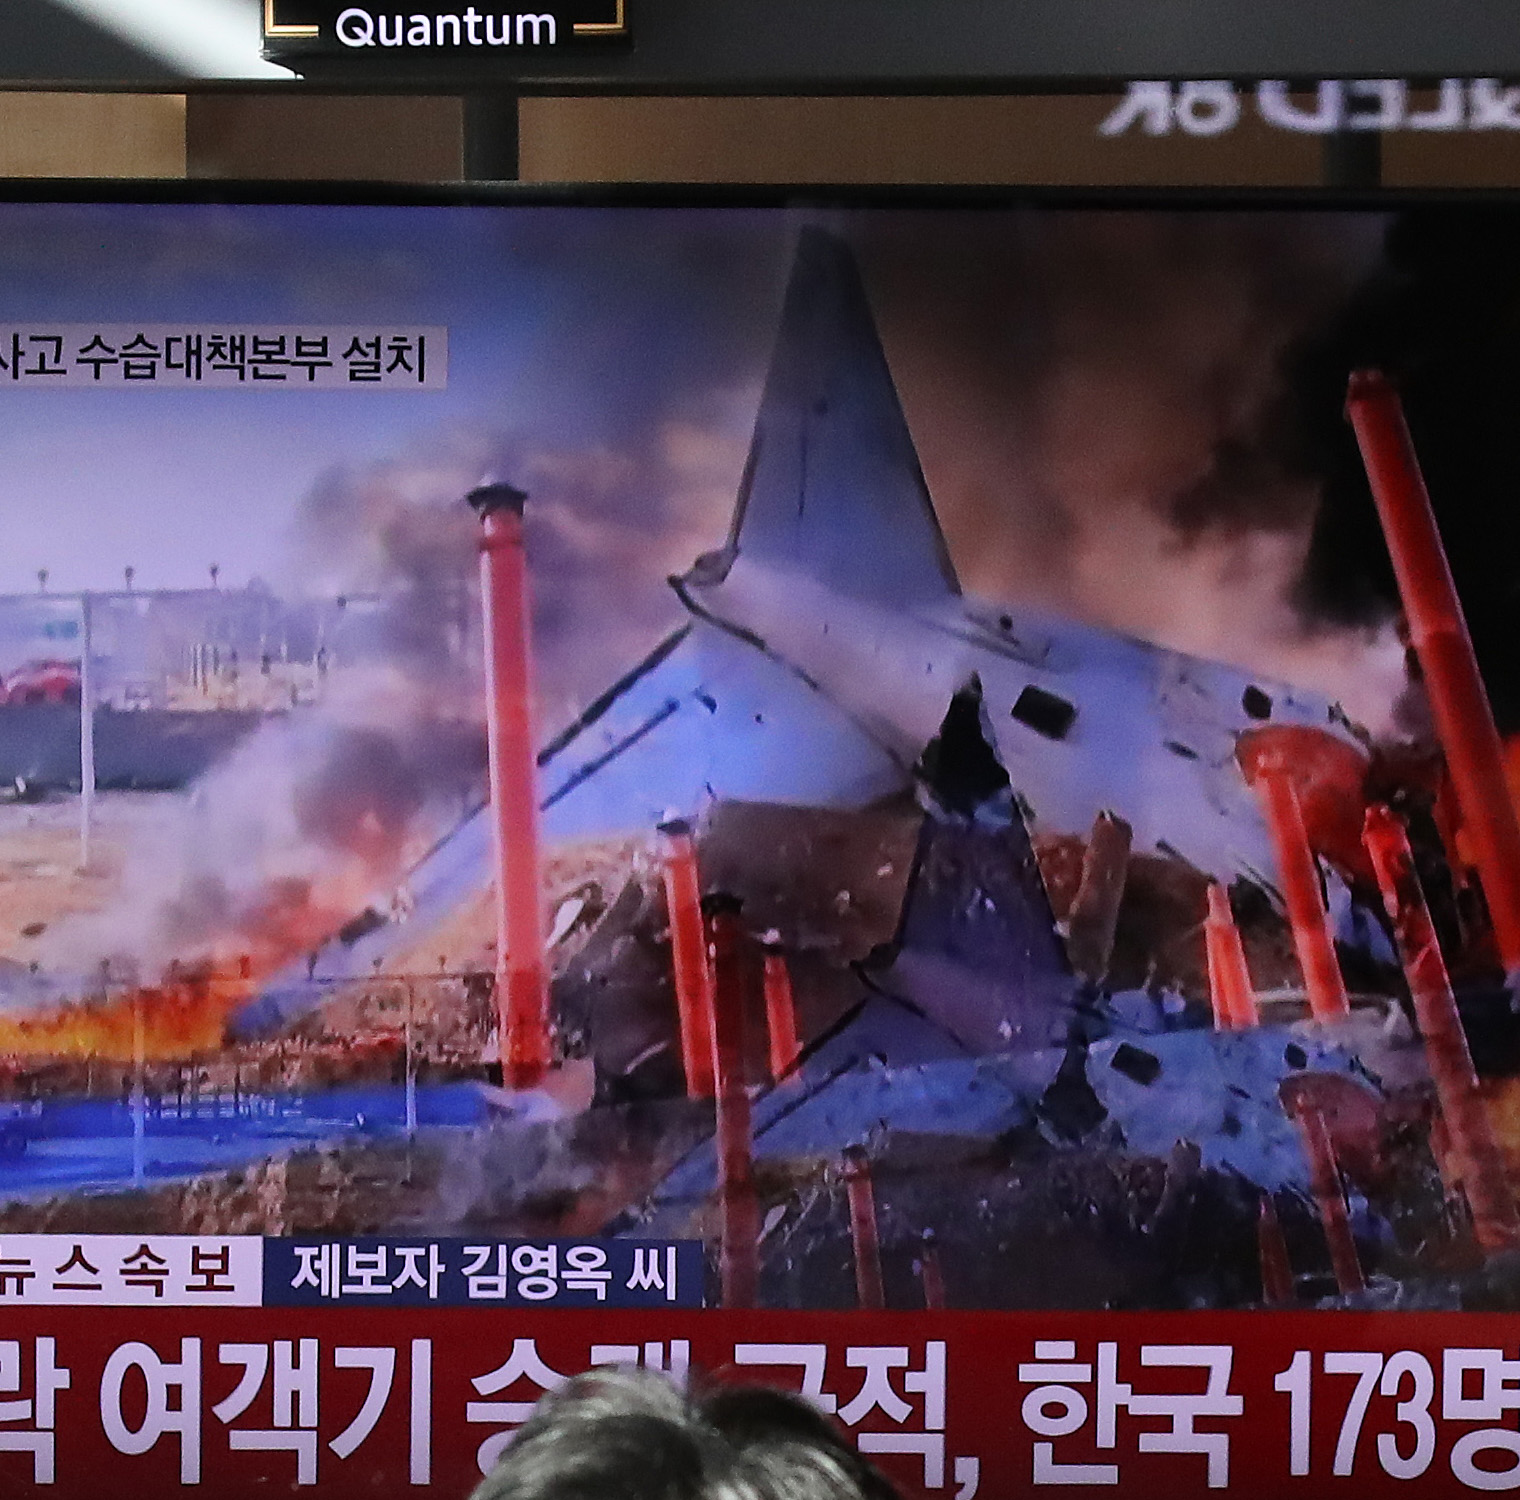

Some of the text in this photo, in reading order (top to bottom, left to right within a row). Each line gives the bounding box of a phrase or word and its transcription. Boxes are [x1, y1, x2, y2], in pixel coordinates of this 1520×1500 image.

[335, 7, 557, 47] Quantum
[76, 333, 333, 381] 수습대책본부
[342, 336, 426, 383] 설치
[291, 1243, 679, 1301] 제보자 김영옥 씨
[100, 1336, 432, 1486] 여객기
[1018, 1340, 1244, 1488] 한국
